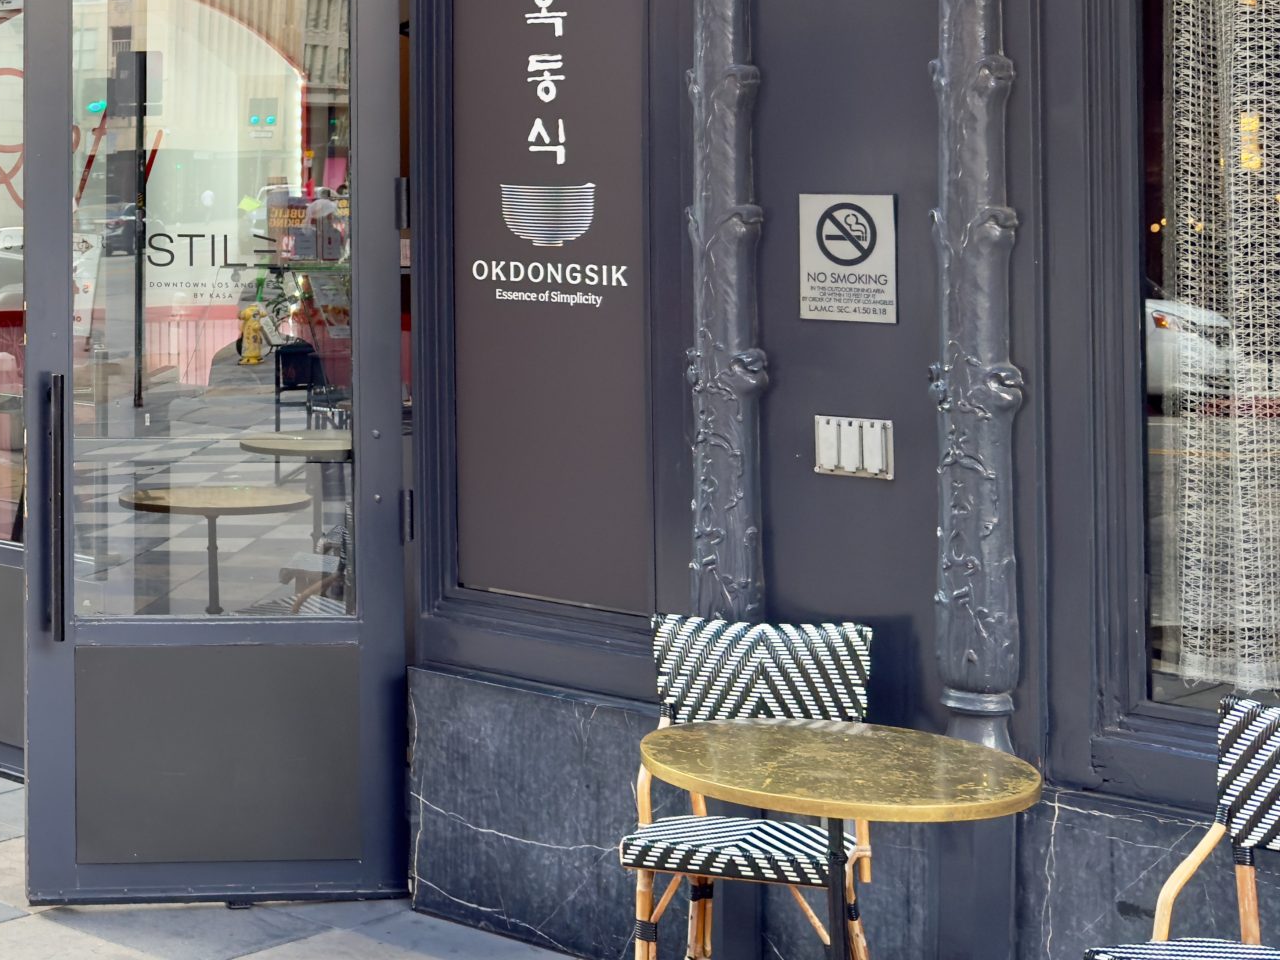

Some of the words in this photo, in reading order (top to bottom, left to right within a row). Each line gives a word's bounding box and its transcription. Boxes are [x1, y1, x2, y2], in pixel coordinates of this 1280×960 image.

[472, 259, 628, 287] OKDONGSIK
[807, 272, 827, 283] NO
[830, 272, 888, 286] SMOKING
[495, 288, 537, 301] Essence
[538, 290, 549, 302] of
[550, 291, 603, 308] Simplicity
